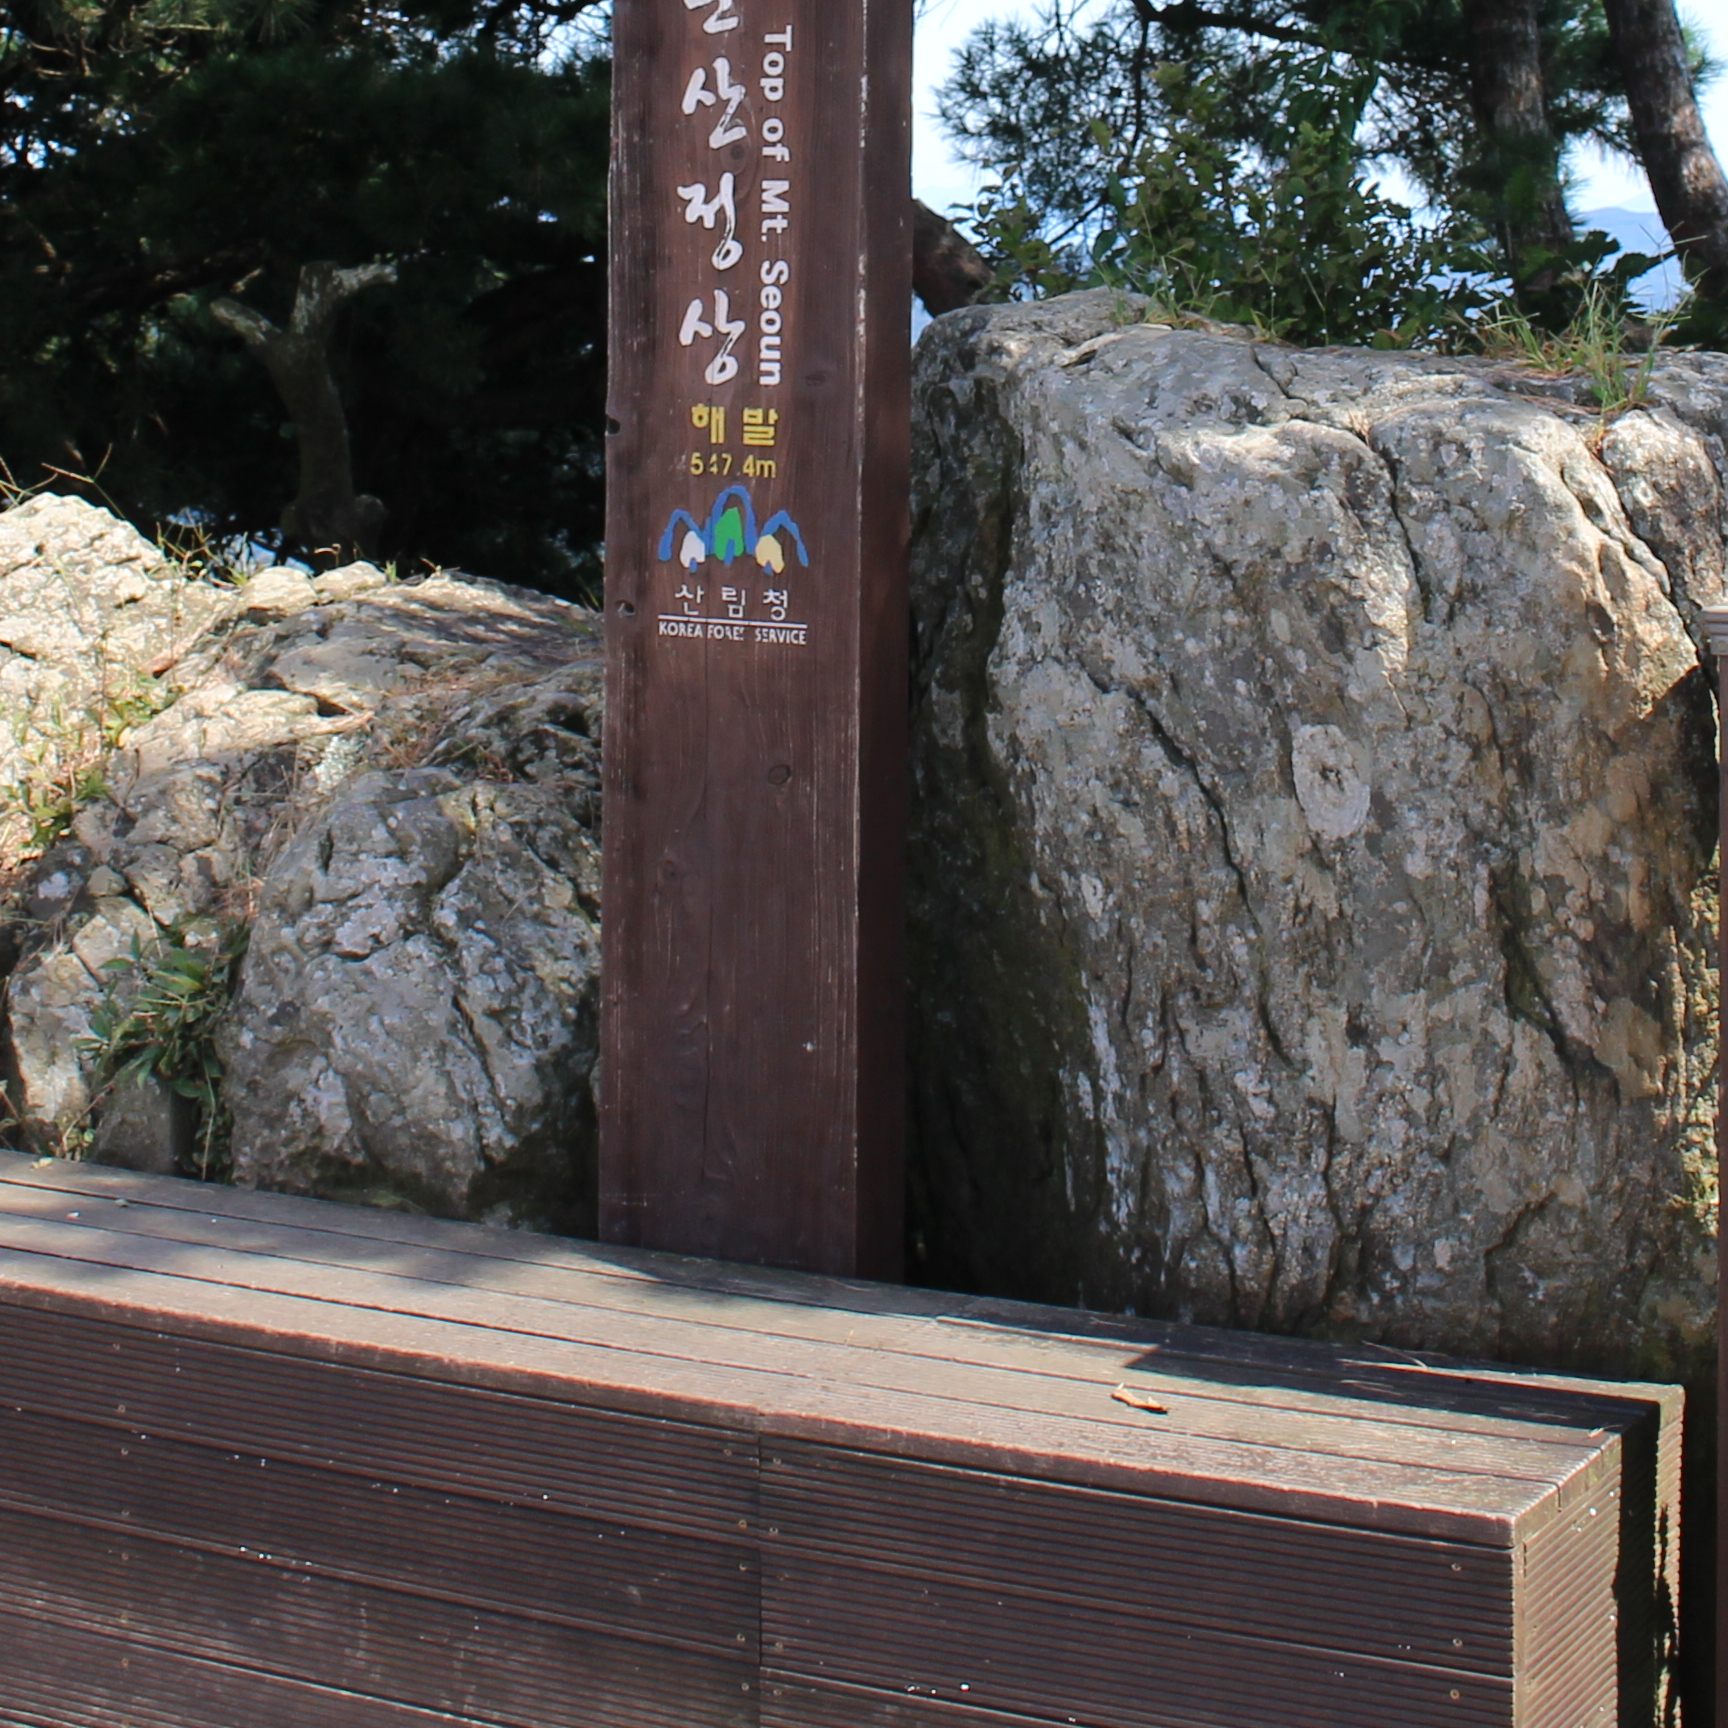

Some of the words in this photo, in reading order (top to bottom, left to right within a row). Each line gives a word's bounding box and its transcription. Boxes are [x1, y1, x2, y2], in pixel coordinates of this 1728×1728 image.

[759, 24, 793, 102] Top
[761, 117, 791, 162] of
[760, 179, 791, 243] Mt.
[758, 260, 790, 386] Seoun
[691, 403, 779, 446] 해발
[674, 584, 788, 621] 산림청
[658, 621, 704, 638] KOREA
[754, 627, 807, 645] SERVICE
